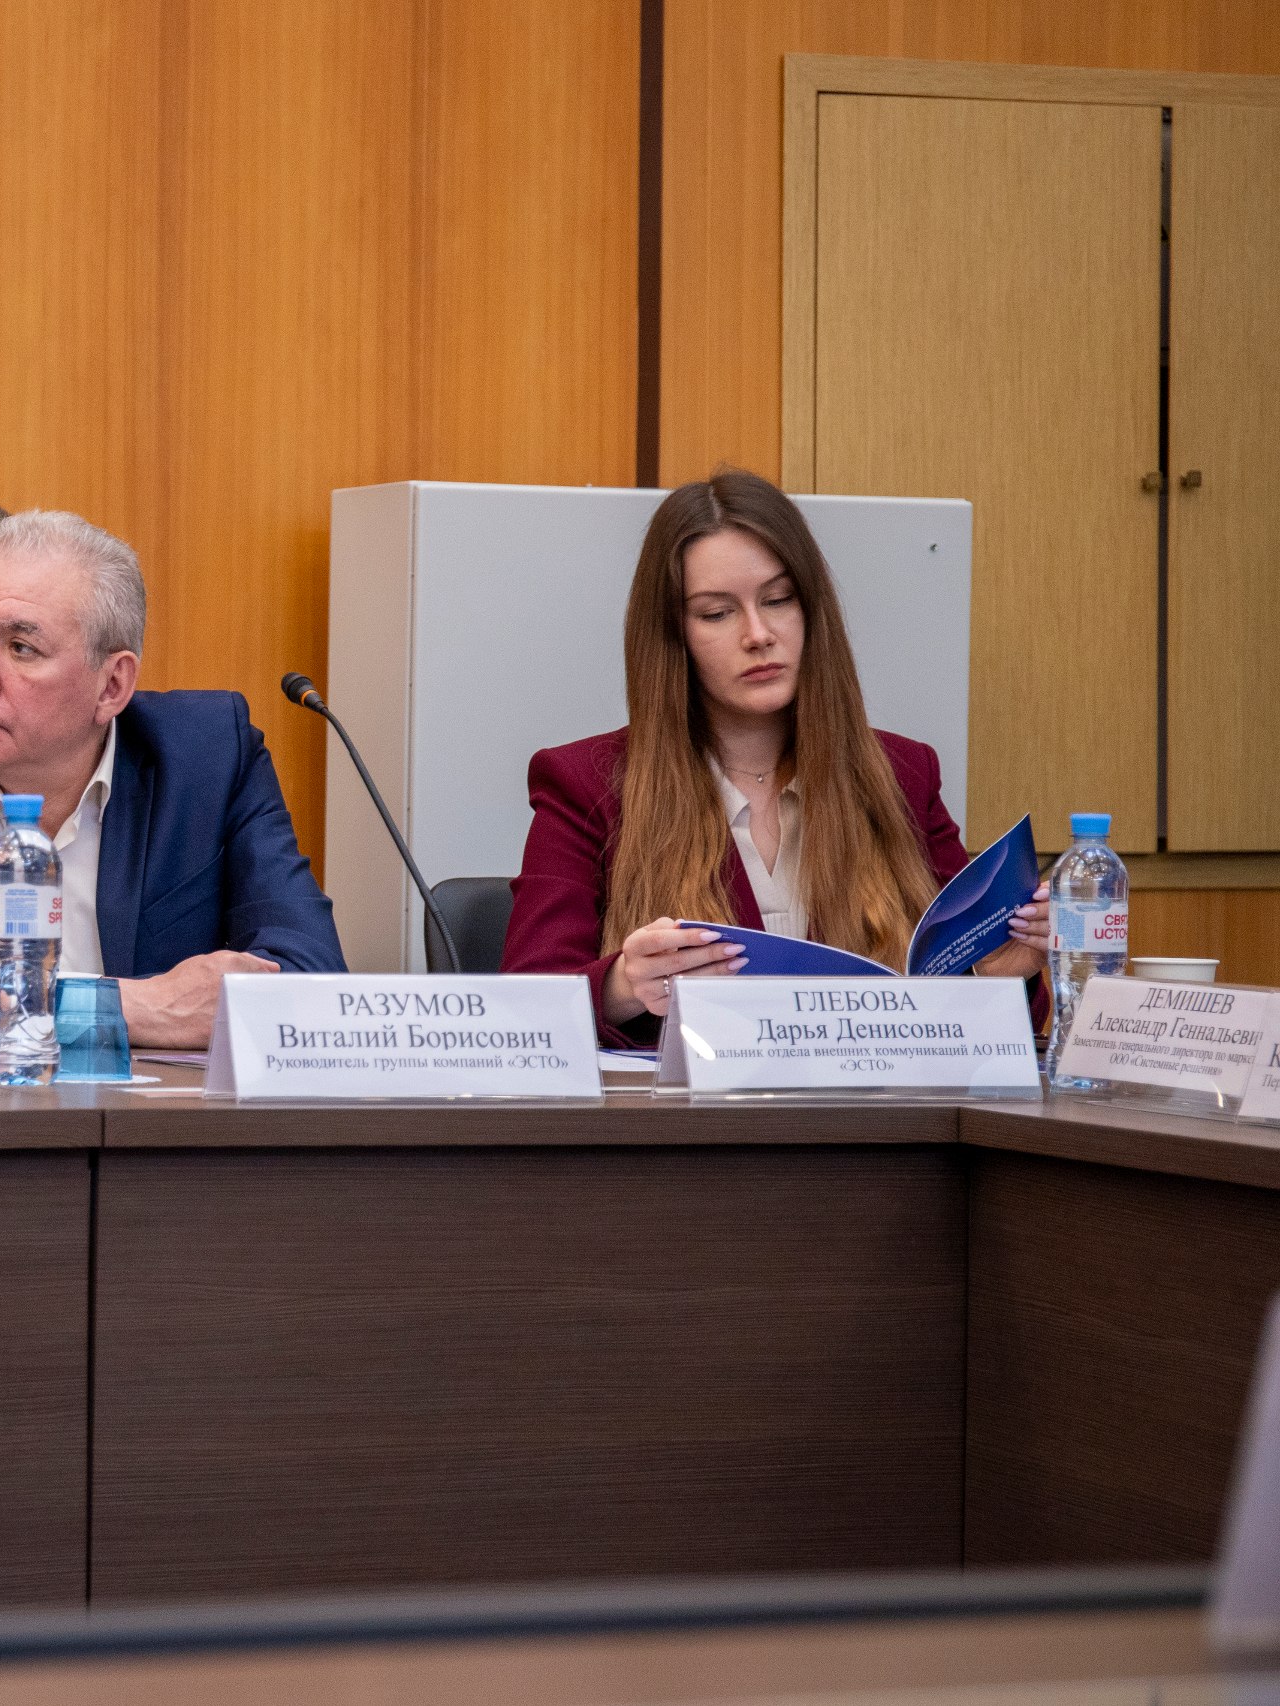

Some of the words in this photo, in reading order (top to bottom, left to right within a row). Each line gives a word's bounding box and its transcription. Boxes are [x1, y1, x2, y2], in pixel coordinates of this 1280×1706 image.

[338, 993, 486, 1017] РАЗУМОВ
[793, 991, 919, 1012] ГЛЕБОВА
[1138, 987, 1236, 1015] ДЕМИШЕВ
[278, 1024, 398, 1049] Виталий
[409, 1024, 553, 1051] Борисович
[757, 1019, 828, 1044] Дарья
[837, 1018, 964, 1044] Денисовна
[1090, 1011, 1168, 1042] Александр
[768, 1046, 811, 1059] отдела
[814, 1045, 871, 1057] внешних
[875, 1043, 969, 1059] коммуникаций
[972, 1043, 993, 1056] АО
[996, 1043, 1028, 1056] НПП
[1072, 1034, 1117, 1050] Заместитель
[1118, 1040, 1171, 1056] генерального
[1171, 1047, 1213, 1062] директора
[266, 1054, 369, 1070] Руководитель
[373, 1057, 428, 1072] группы
[432, 1054, 503, 1069] компаний
[507, 1055, 569, 1069] «ЭСТО»
[839, 1059, 895, 1072] «ЭСТО»
[1109, 1052, 1129, 1065] ООО
[1130, 1056, 1179, 1072] «Системные
